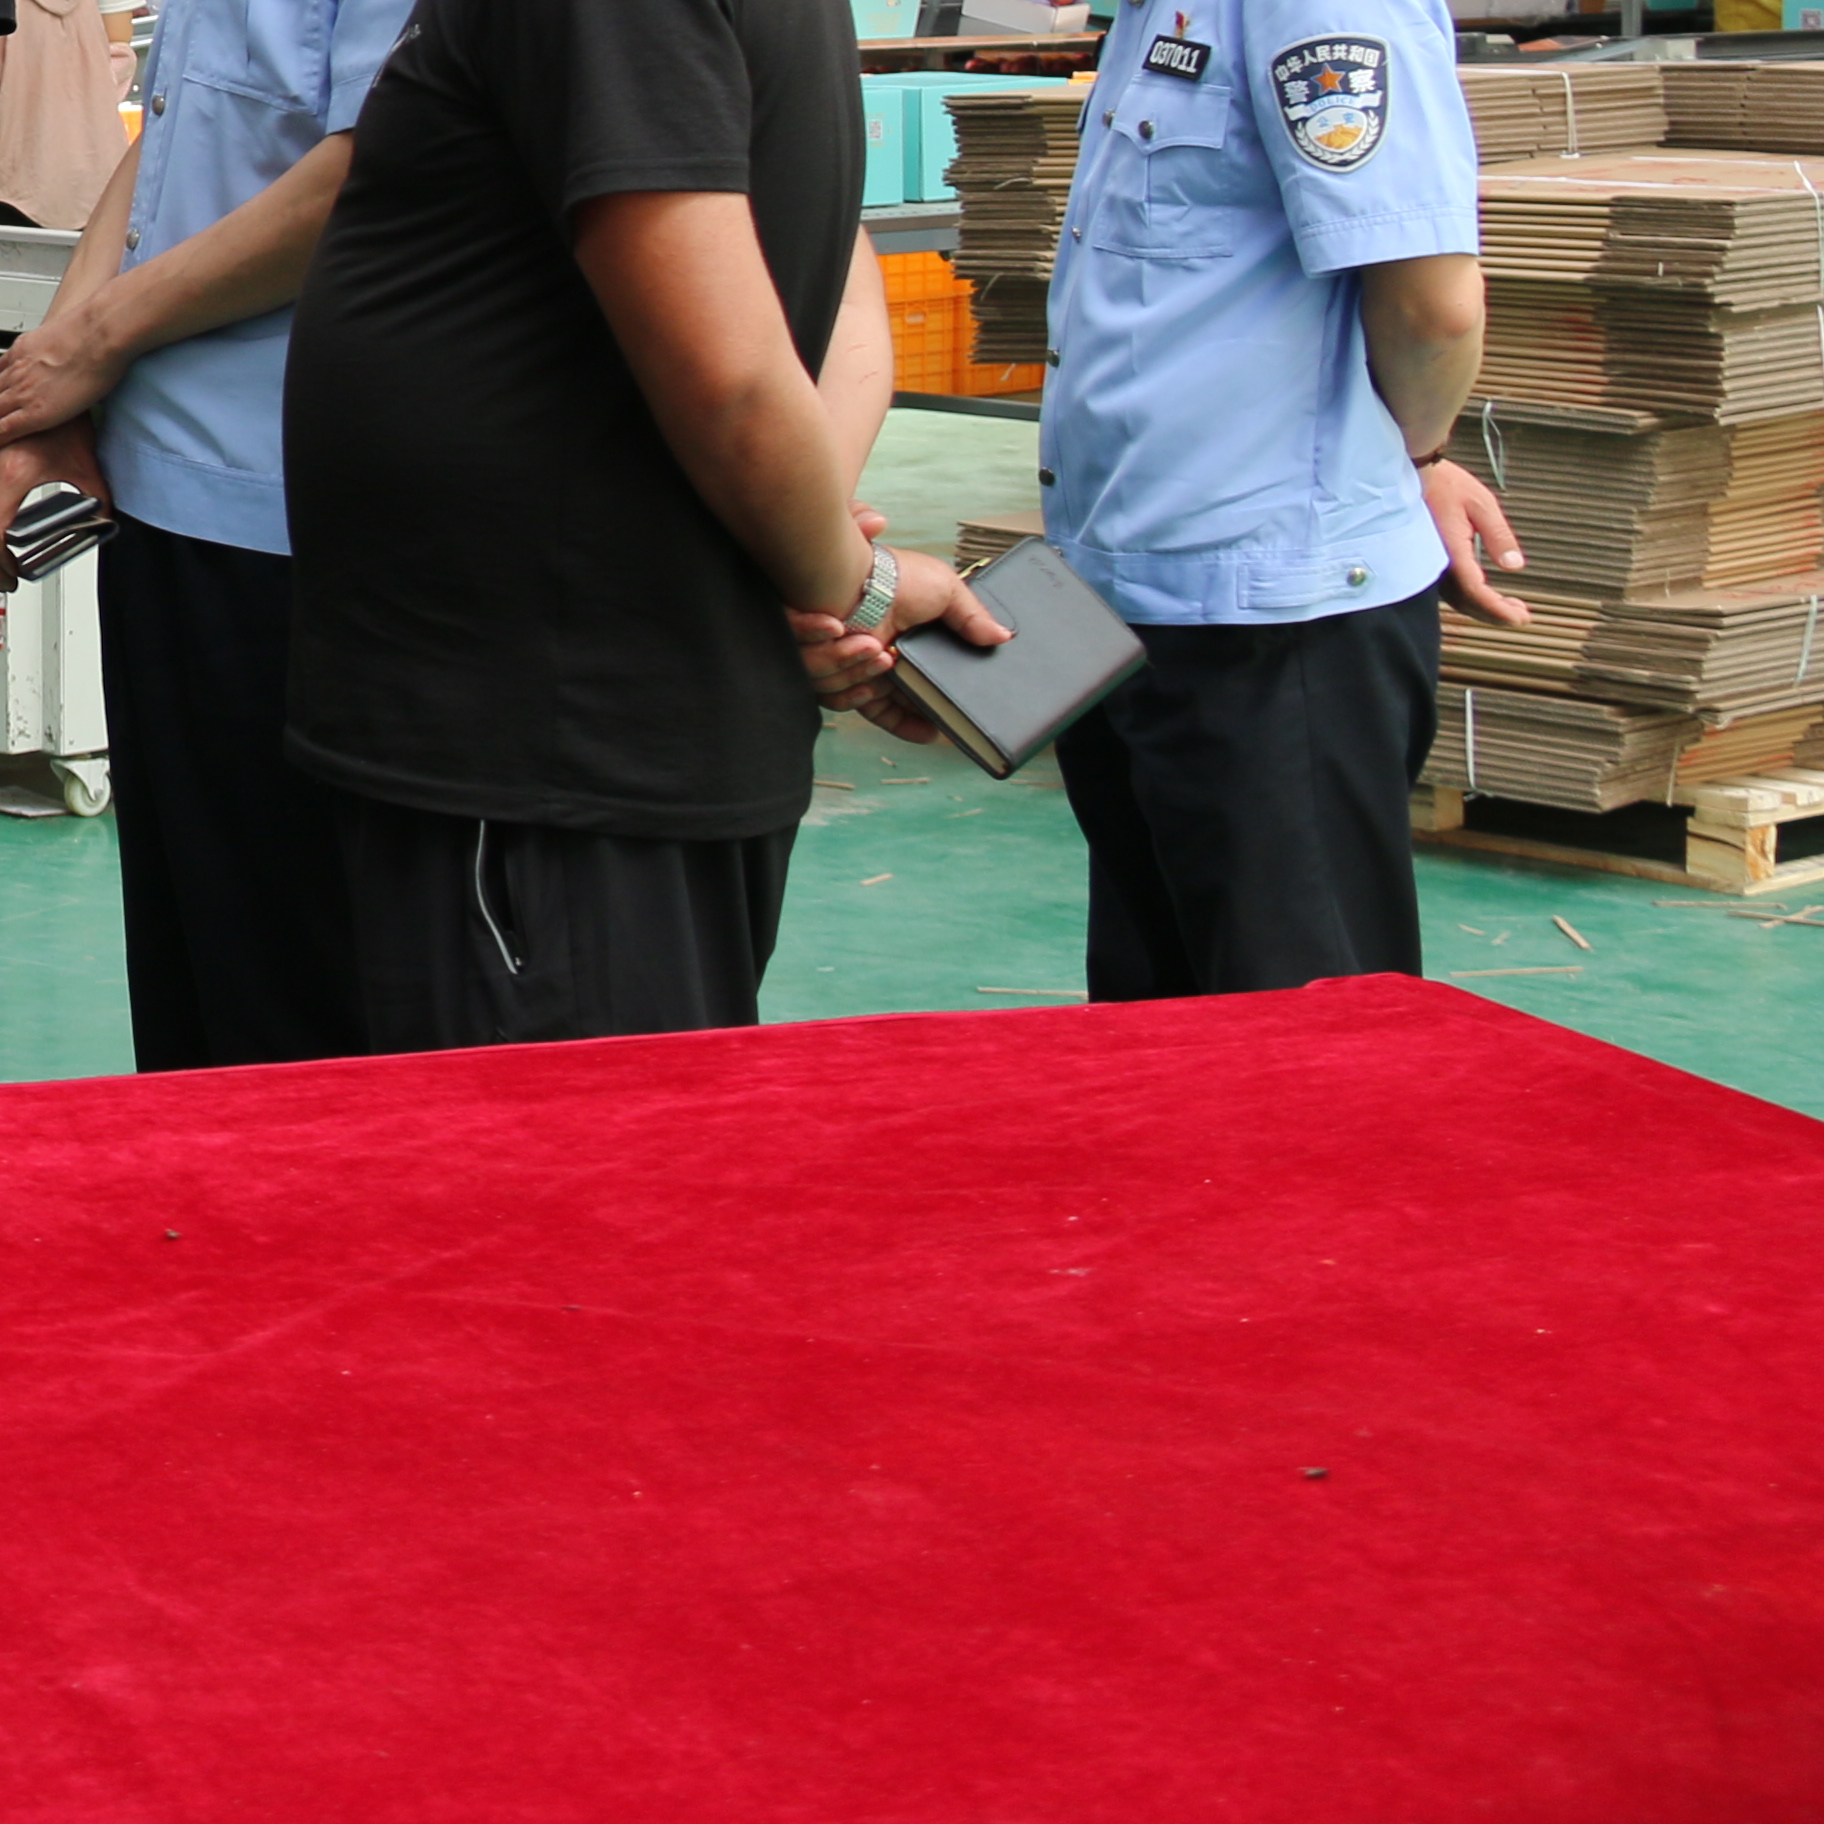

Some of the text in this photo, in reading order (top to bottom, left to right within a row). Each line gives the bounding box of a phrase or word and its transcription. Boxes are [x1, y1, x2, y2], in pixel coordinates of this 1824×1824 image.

[1149, 41, 1199, 73] 037011
[1274, 43, 1381, 82] 中华人民共和国
[1310, 96, 1356, 112] POLICE
